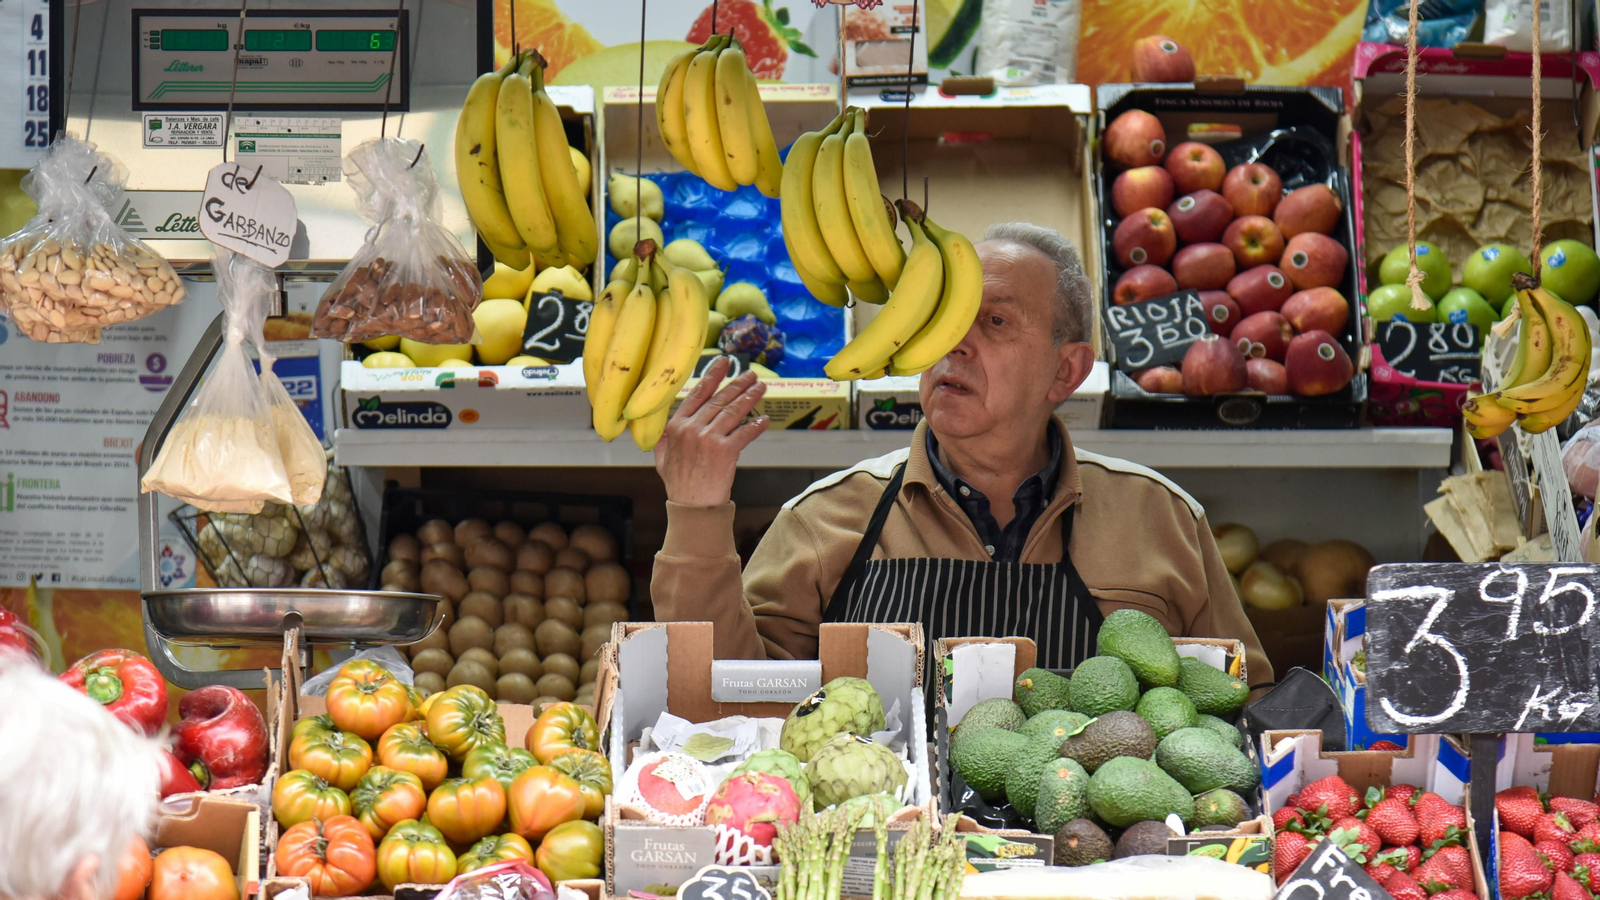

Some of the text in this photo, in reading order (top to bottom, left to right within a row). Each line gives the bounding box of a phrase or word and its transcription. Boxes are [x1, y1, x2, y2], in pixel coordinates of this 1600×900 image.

[31, 14, 44, 40] 4
[370, 33, 381, 50] 6
[27, 49, 47, 76] 11
[27, 84, 49, 112] 18
[24, 119, 49, 148] 25
[184, 122, 217, 130] VERGARA
[154, 212, 201, 233] Lette
[205, 197, 291, 248] GARBANZO
[1107, 293, 1205, 331] RIOJA
[1428, 322, 1475, 354] 80
[97, 353, 136, 365] POBREZA
[118, 367, 138, 375] riesgo
[522, 367, 560, 377] Melinda
[14, 391, 61, 403] ABANDONO
[526, 389, 582, 397] www.melinda.it
[356, 407, 448, 426] Melinda
[103, 437, 135, 448] BREXIT
[17, 477, 62, 490] FRONTERA
[67, 494, 101, 502] demuestra
[1371, 567, 1596, 727] 3 95
[722, 677, 808, 689] Frutas GARSAN
[644, 838, 686, 851] Frutas
[630, 850, 698, 864] GARSAN
[1311, 843, 1372, 900] Fre
